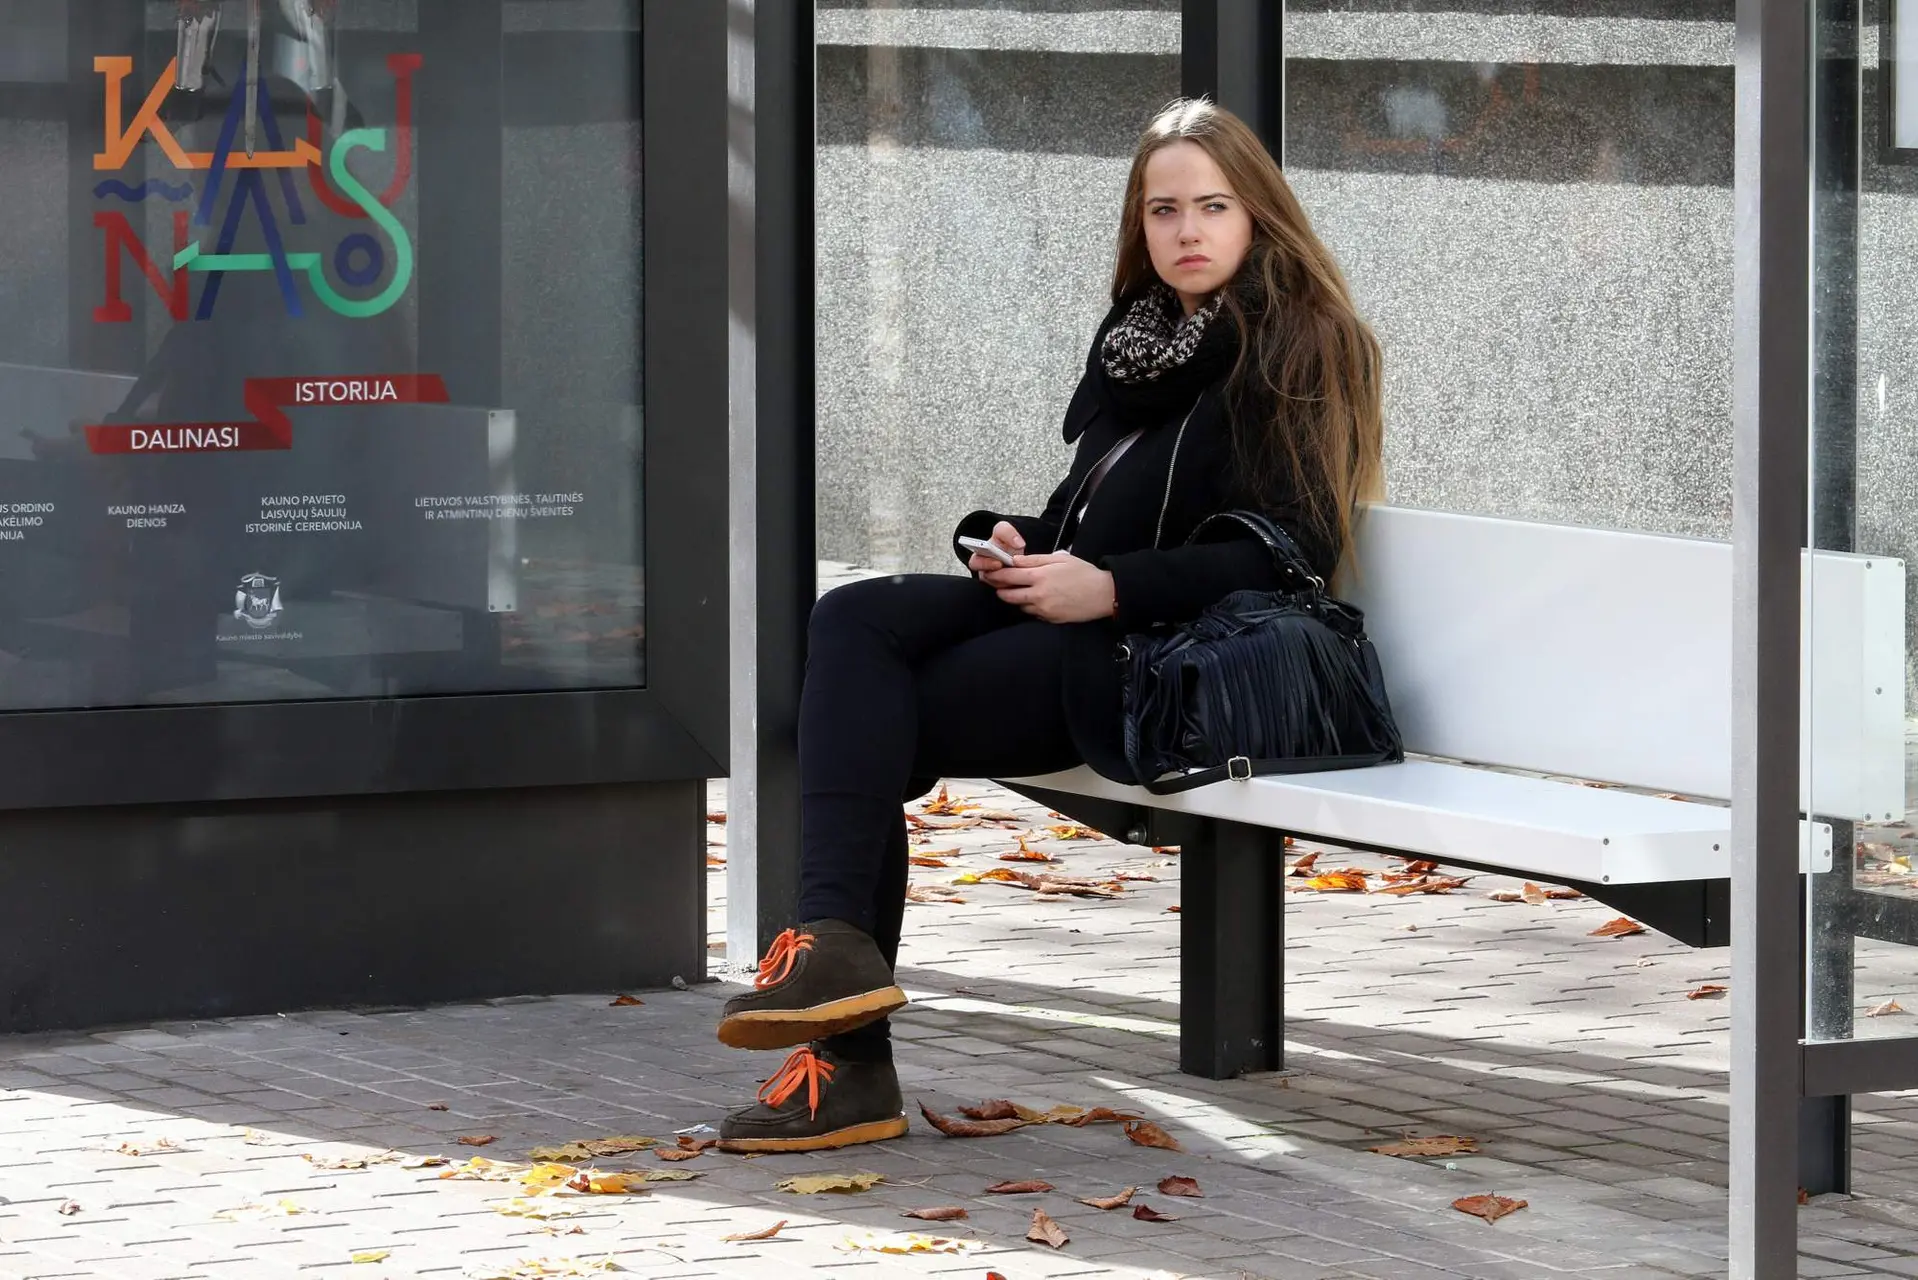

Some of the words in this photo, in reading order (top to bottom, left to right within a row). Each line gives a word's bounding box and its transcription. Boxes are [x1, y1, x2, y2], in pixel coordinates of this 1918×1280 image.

[295, 381, 398, 402] ISTORIJA
[130, 427, 240, 450] DALINASI
[261, 495, 300, 506] KAUNO
[302, 494, 346, 504] PAVIETO
[415, 497, 462, 507] LIETUVOS
[535, 491, 584, 504] TAUTINĖS
[11, 502, 55, 513] ORDINO
[107, 505, 146, 515] KAUNO
[148, 503, 186, 514] HANZA
[260, 509, 309, 520] LAISVŲJŲ
[311, 507, 347, 519] ŠAULIŲ
[425, 510, 434, 520] IR
[530, 504, 574, 516] ŠVENTĖS
[126, 517, 167, 528] DIENOS
[245, 520, 293, 533] ISTORINĖ
[295, 521, 363, 532] CEREMONIJA
